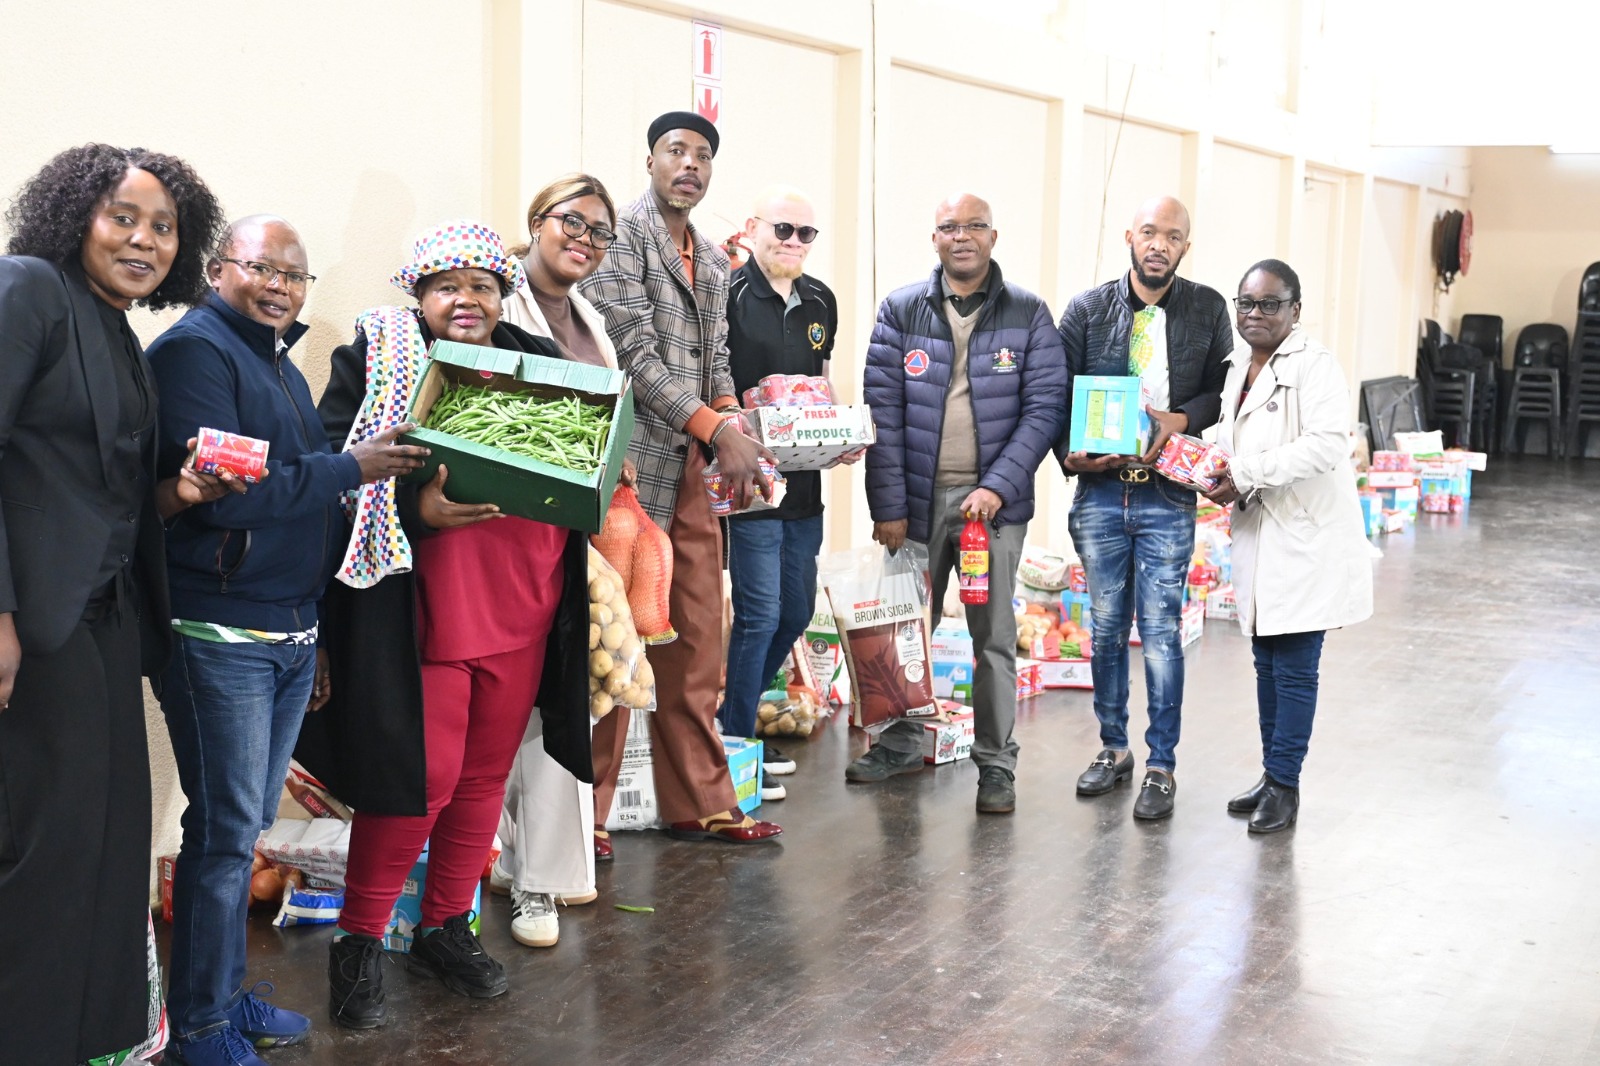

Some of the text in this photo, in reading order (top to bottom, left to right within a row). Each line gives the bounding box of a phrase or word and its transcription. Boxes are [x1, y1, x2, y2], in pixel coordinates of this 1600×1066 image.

[804, 410, 837, 420] FRESH
[797, 428, 853, 440] PRODUCE
[963, 558, 985, 566] ISLAND
[855, 603, 915, 623] BROWN SUGAR
